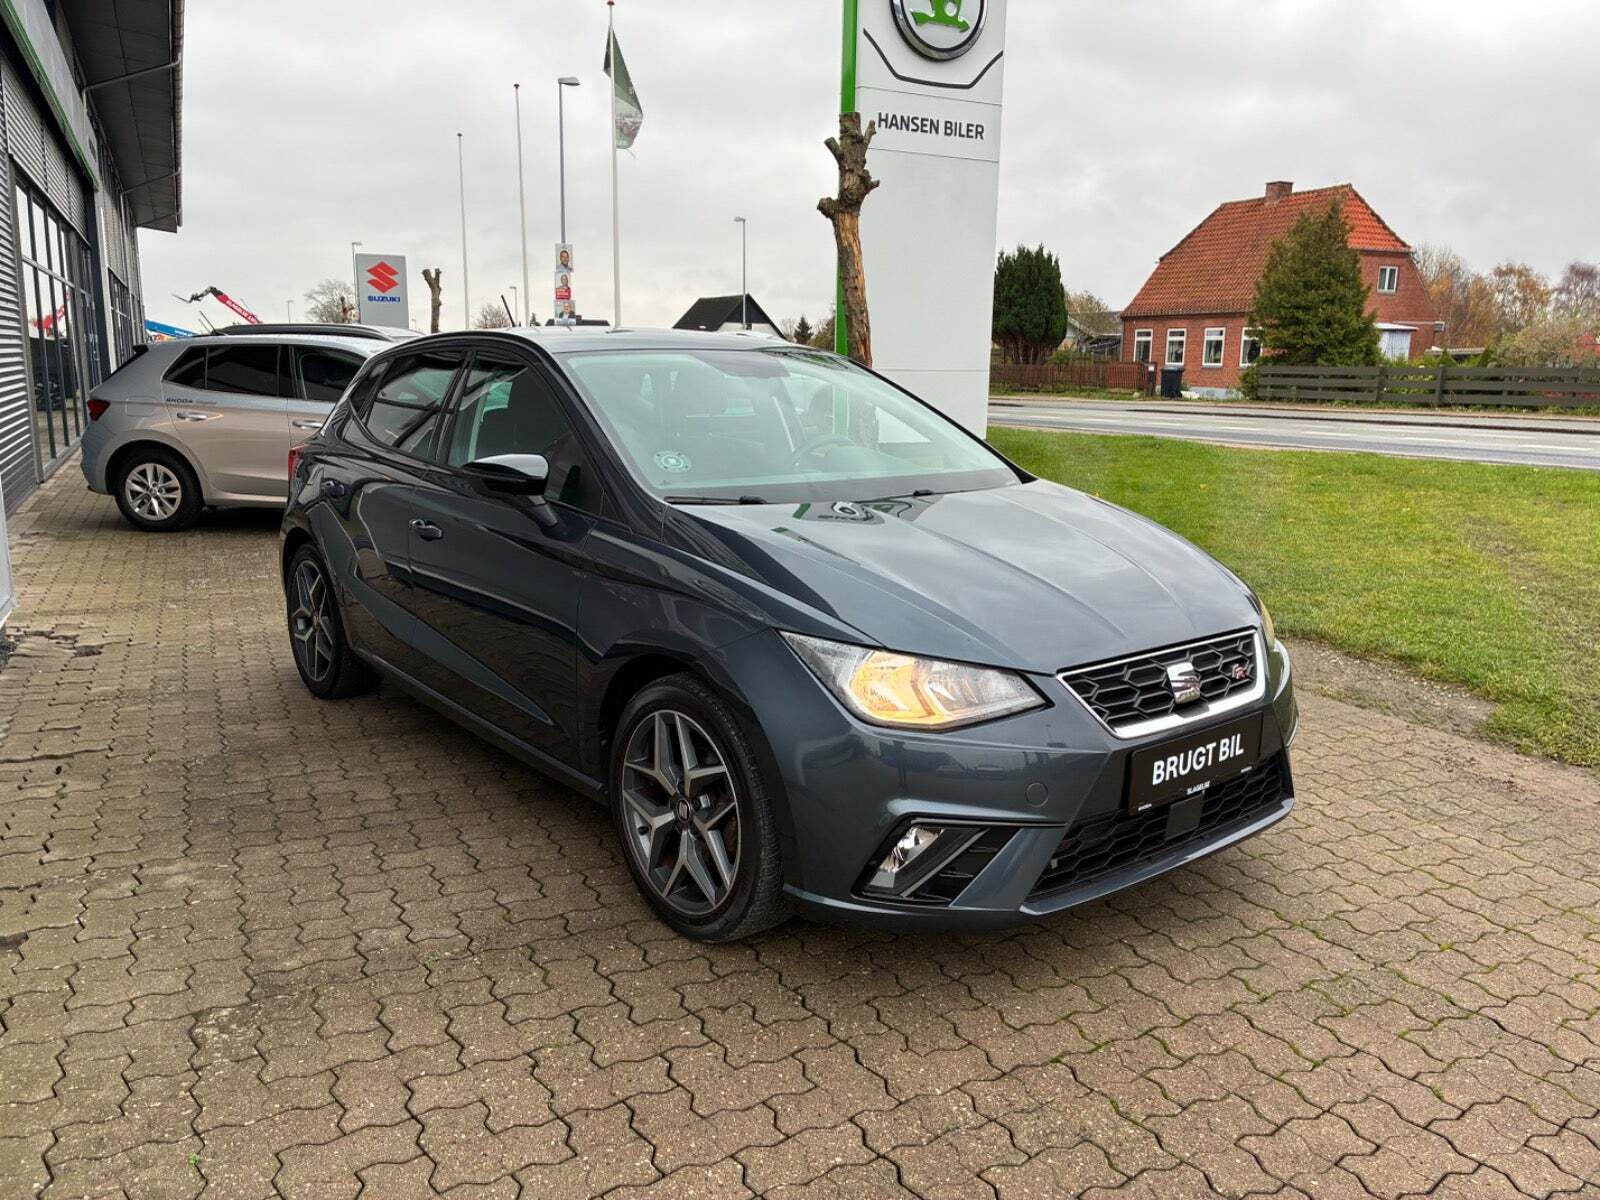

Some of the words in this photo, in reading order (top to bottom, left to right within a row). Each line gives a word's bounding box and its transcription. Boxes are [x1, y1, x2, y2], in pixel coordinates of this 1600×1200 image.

[878, 111, 940, 135] HANSEN
[944, 120, 985, 140] BILER
[367, 295, 401, 303] SUZUKI
[1152, 742, 1216, 785] BRUGT
[1218, 733, 1244, 762] BIL
